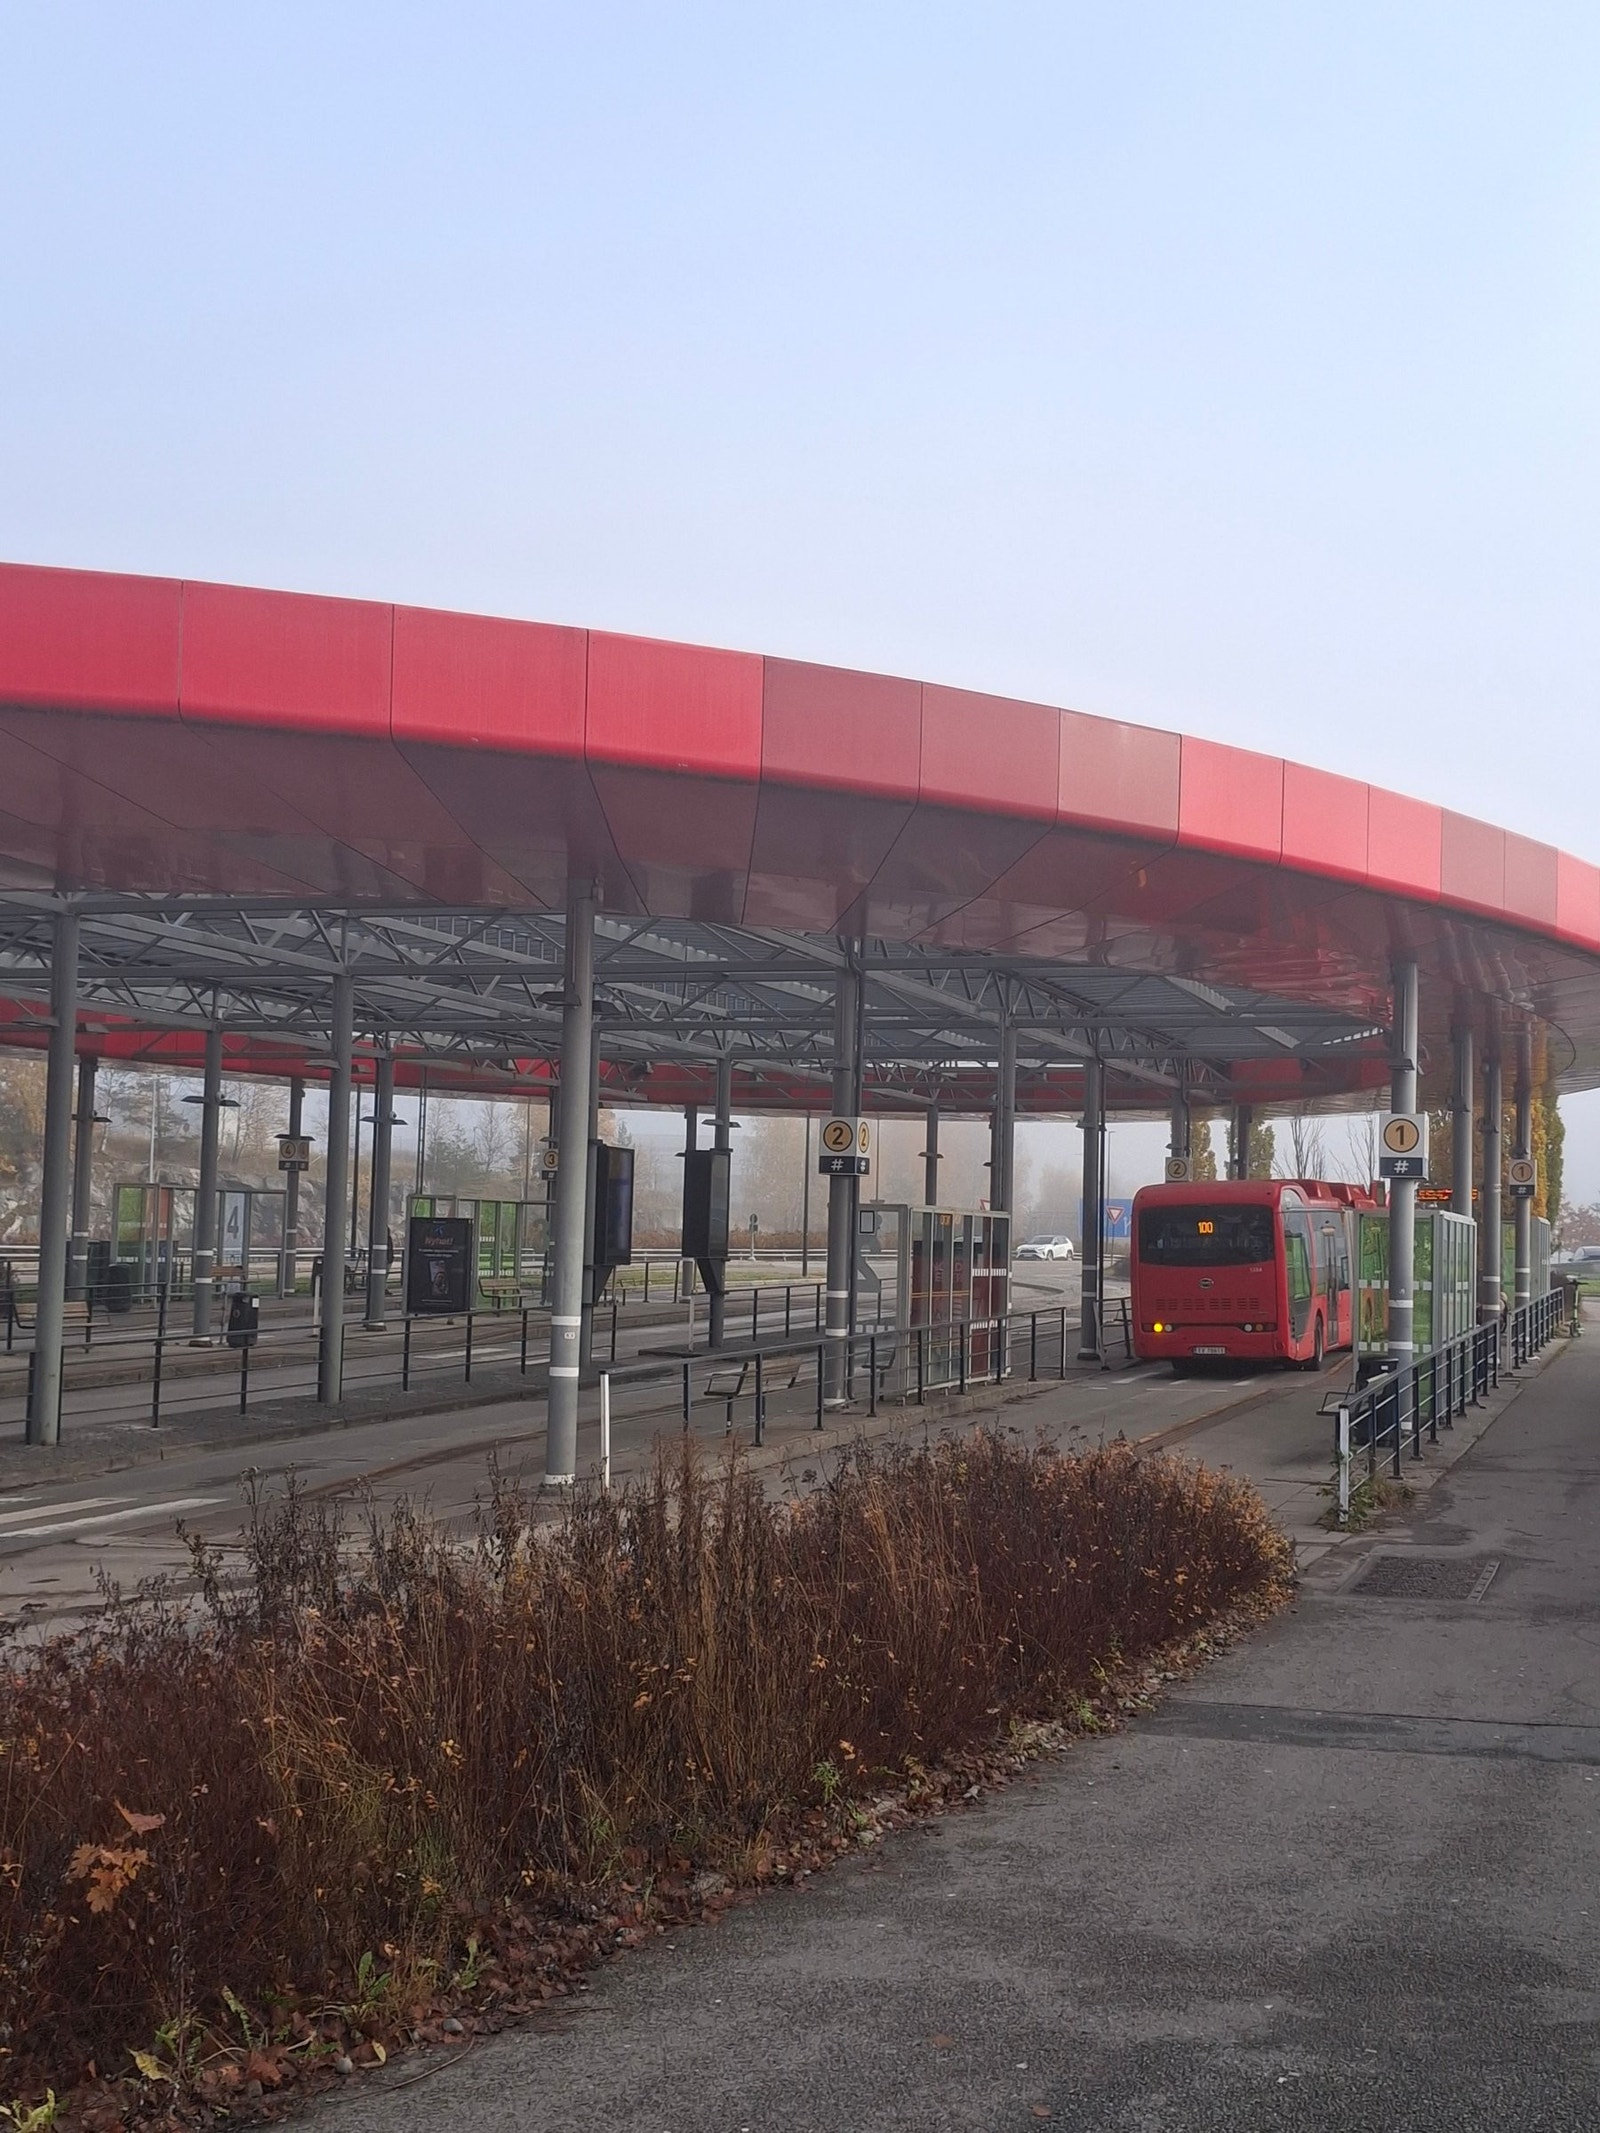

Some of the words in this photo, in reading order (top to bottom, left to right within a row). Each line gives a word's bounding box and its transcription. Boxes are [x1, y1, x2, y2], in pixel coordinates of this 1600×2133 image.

[832, 1126, 844, 1145] 2
[861, 1128, 867, 1147] 2
[1395, 1125, 1405, 1146] 1
[1173, 1162, 1181, 1175] 2
[1518, 1165, 1525, 1178] 1
[227, 1205, 239, 1240] 4
[1197, 1221, 1213, 1234] 100
